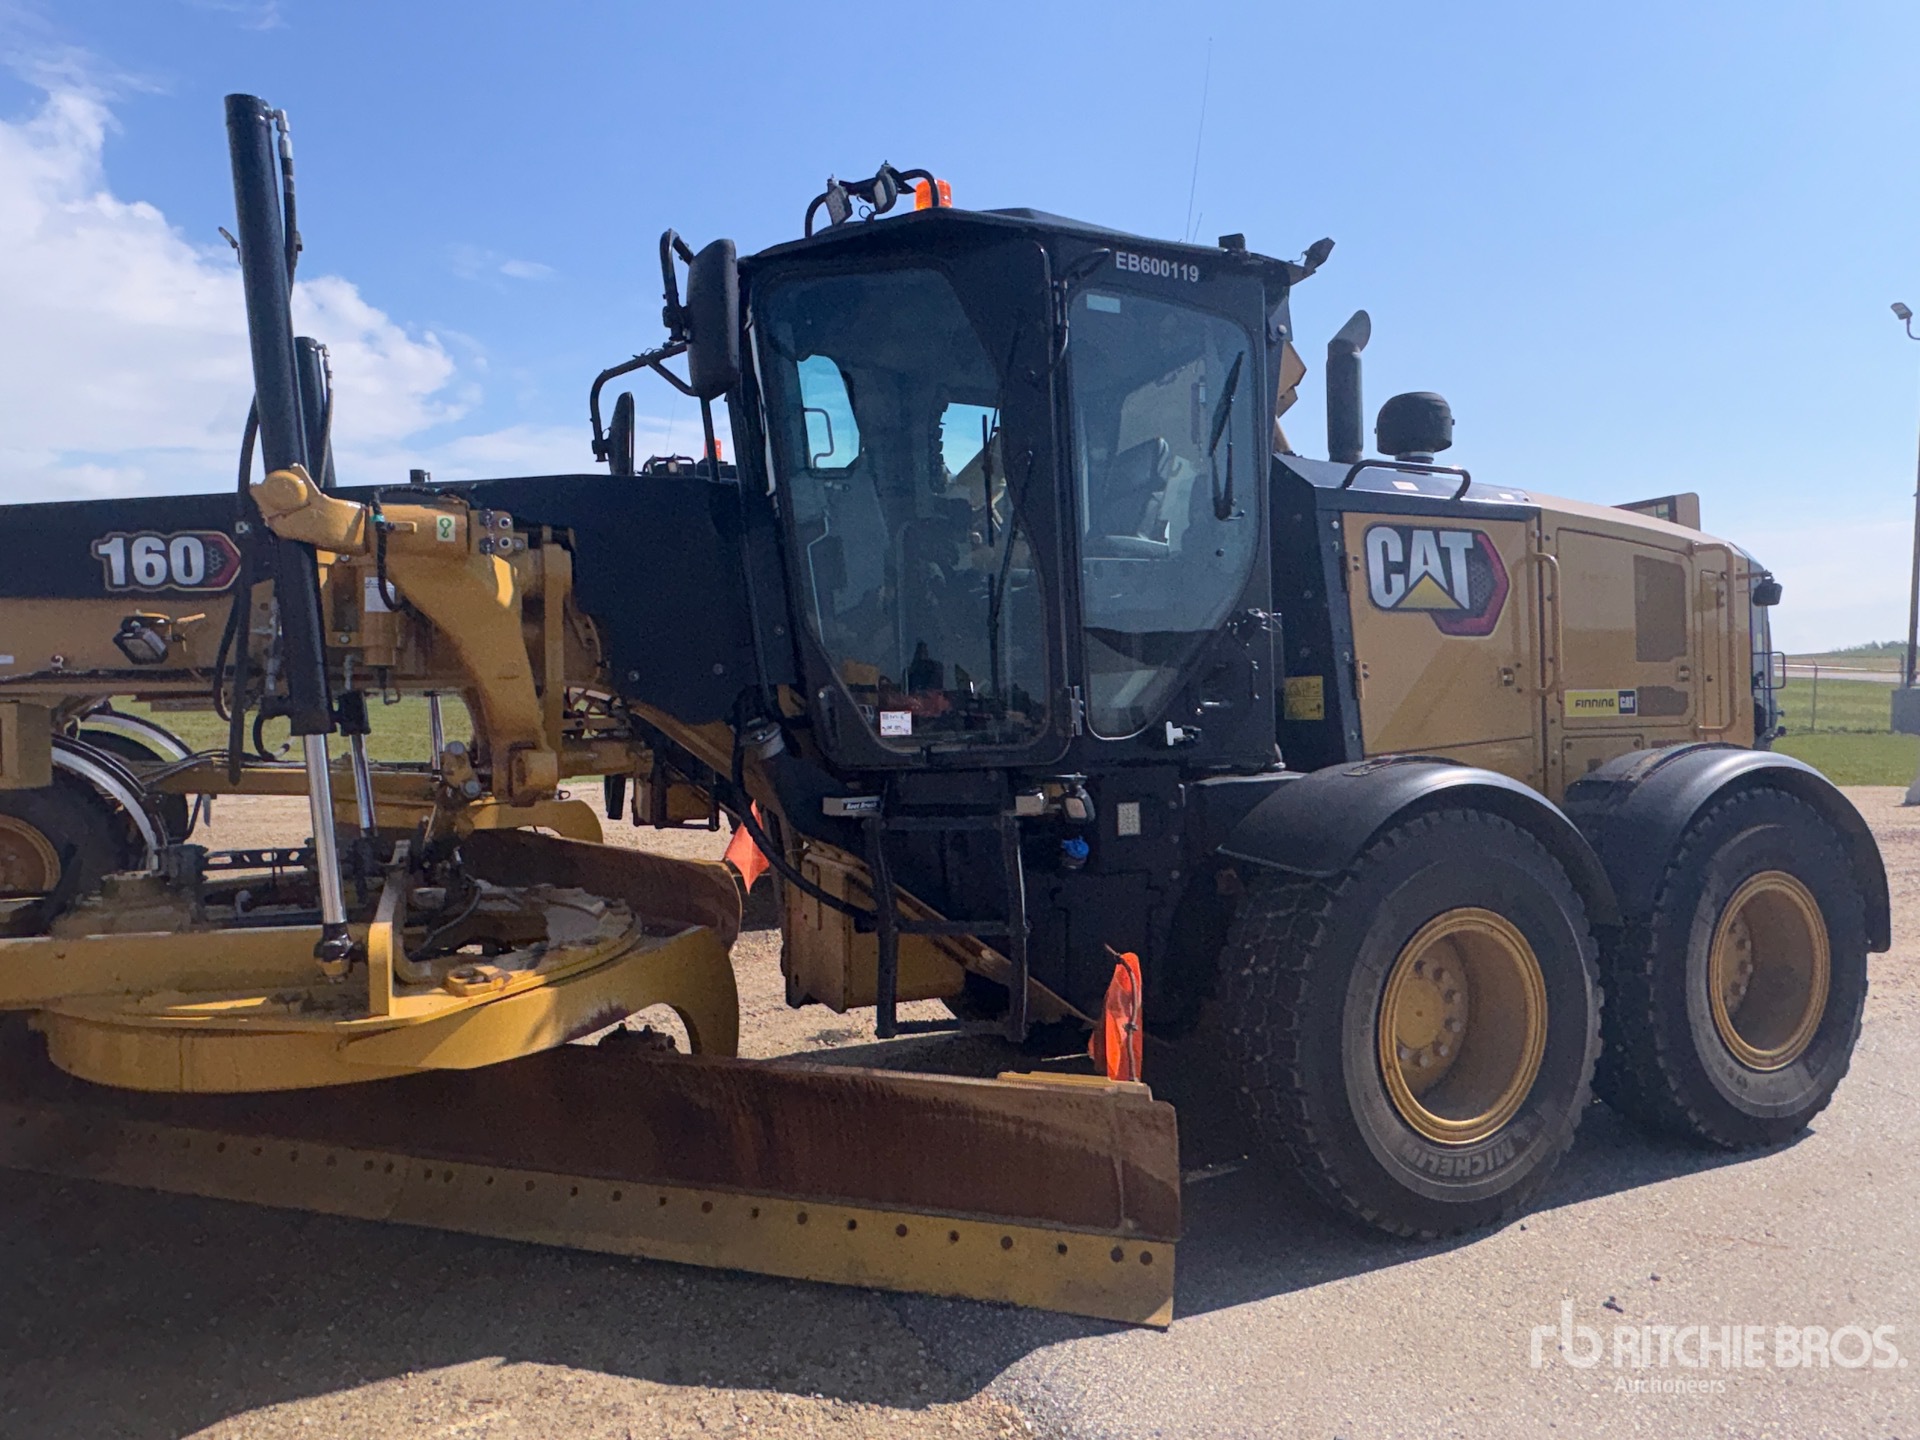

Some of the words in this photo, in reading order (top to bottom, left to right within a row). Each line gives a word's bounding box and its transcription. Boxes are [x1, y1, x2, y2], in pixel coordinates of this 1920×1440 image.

[1115, 251, 1199, 283] EB600119
[98, 536, 205, 586] 160
[1366, 526, 1473, 610] CAT
[1575, 698, 1615, 708] FINNING
[1620, 696, 1634, 708] CAT
